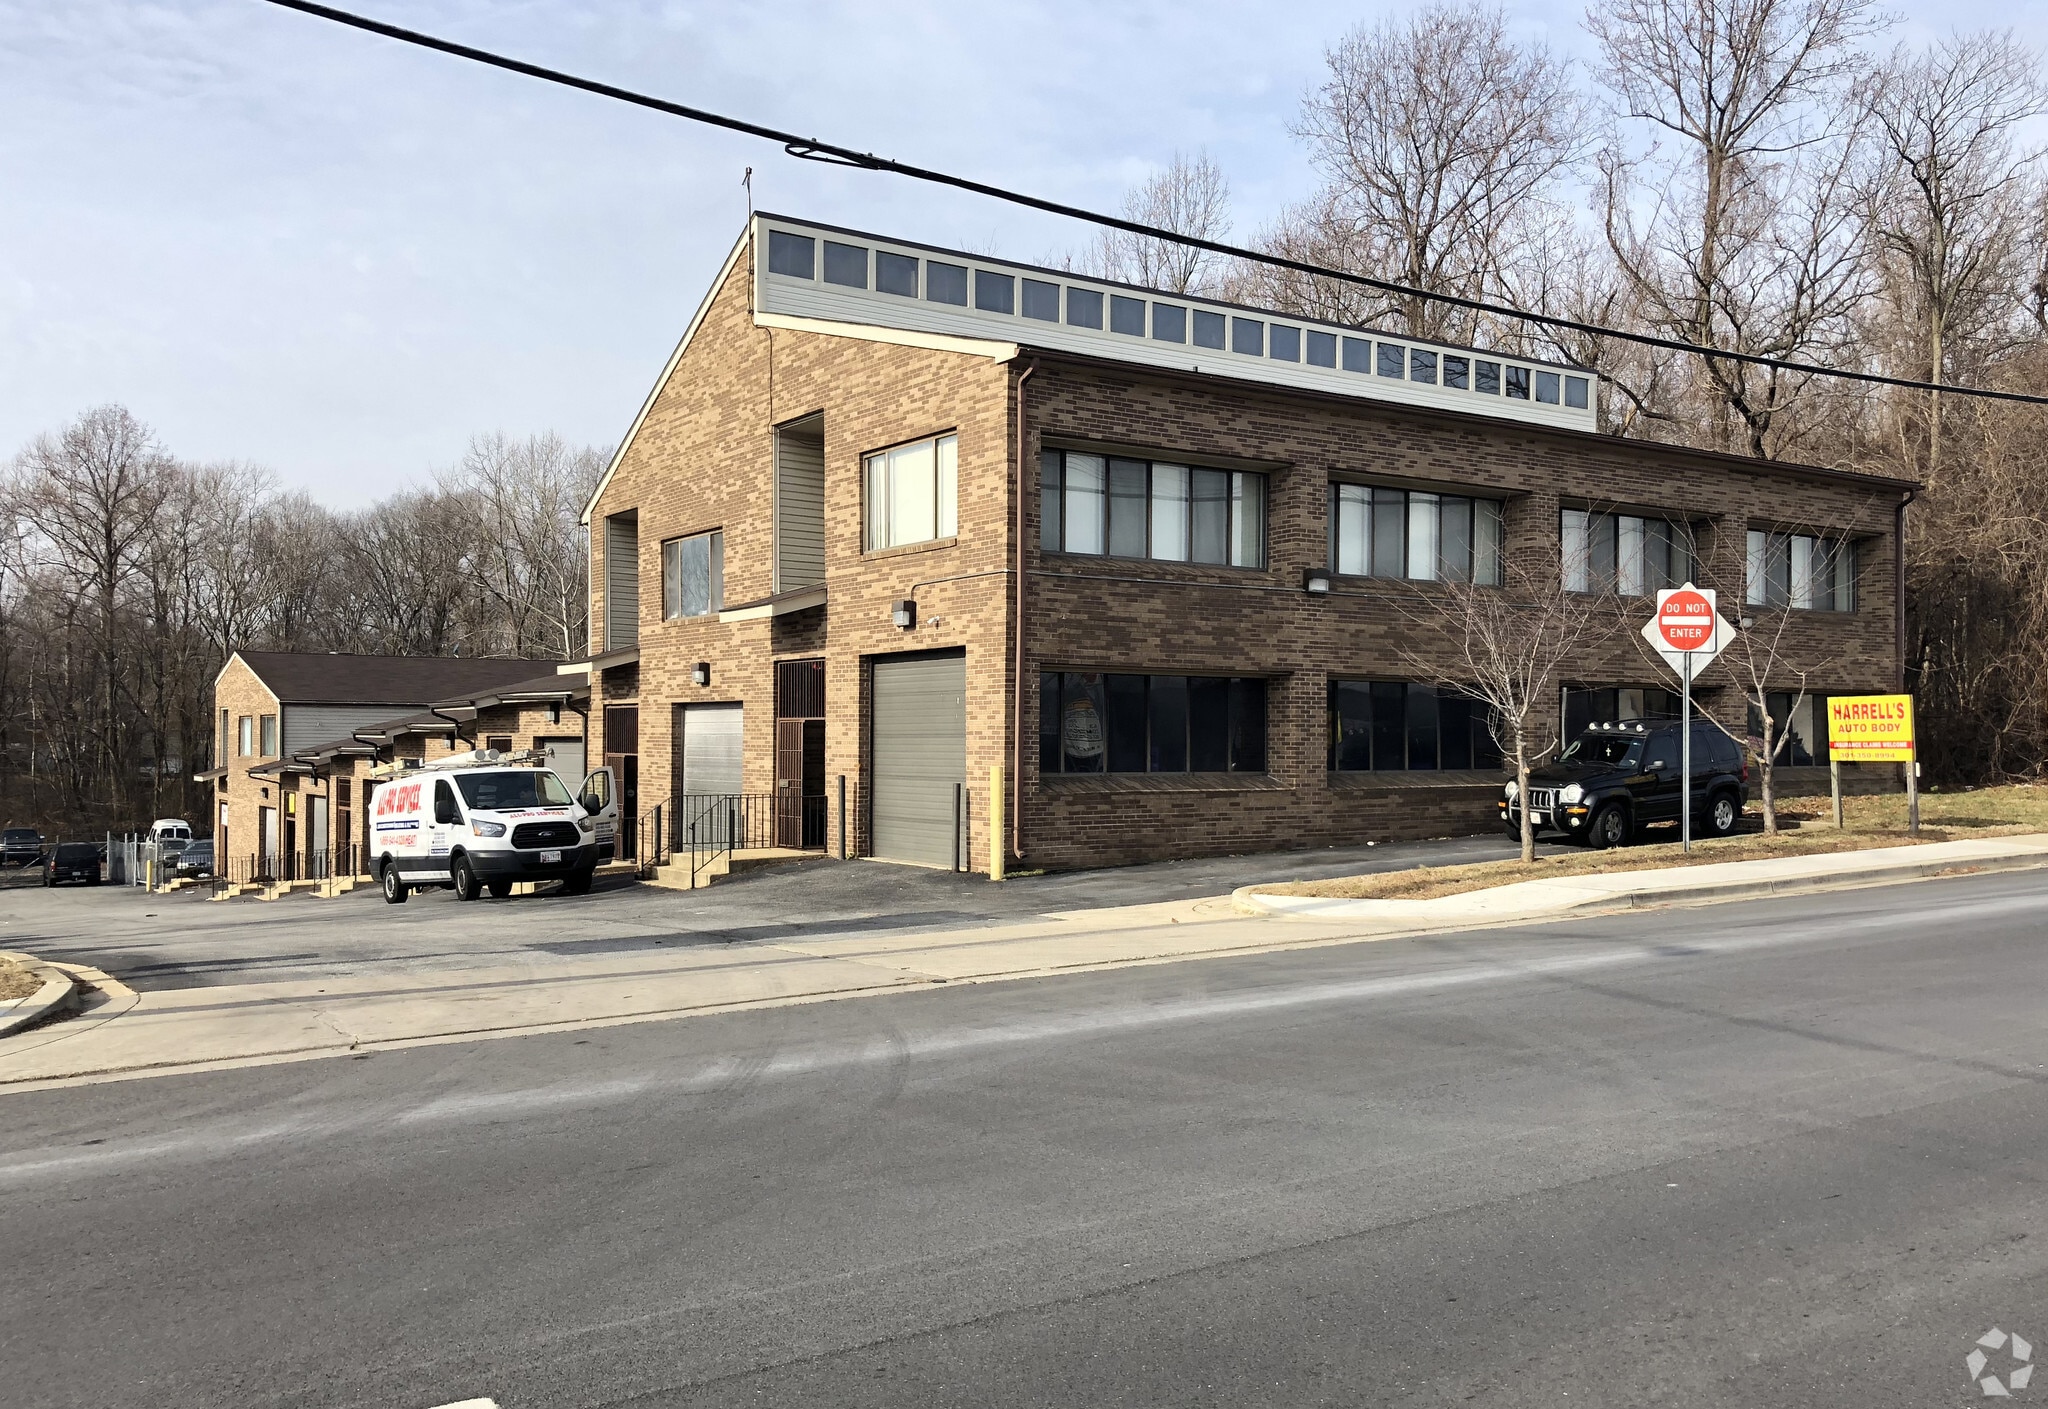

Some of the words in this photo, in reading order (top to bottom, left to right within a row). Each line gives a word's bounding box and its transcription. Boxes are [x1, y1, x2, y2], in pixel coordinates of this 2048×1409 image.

[1666, 603, 1680, 613] DO
[1686, 603, 1706, 613] NOT
[1669, 628, 1702, 638] ENTER
[1833, 702, 1905, 720] HARRELL'S
[1838, 723, 1867, 733] AUTO
[1871, 723, 1900, 732] BODY
[1883, 741, 1907, 749] WELCOME
[396, 783, 421, 813] SERVICES
